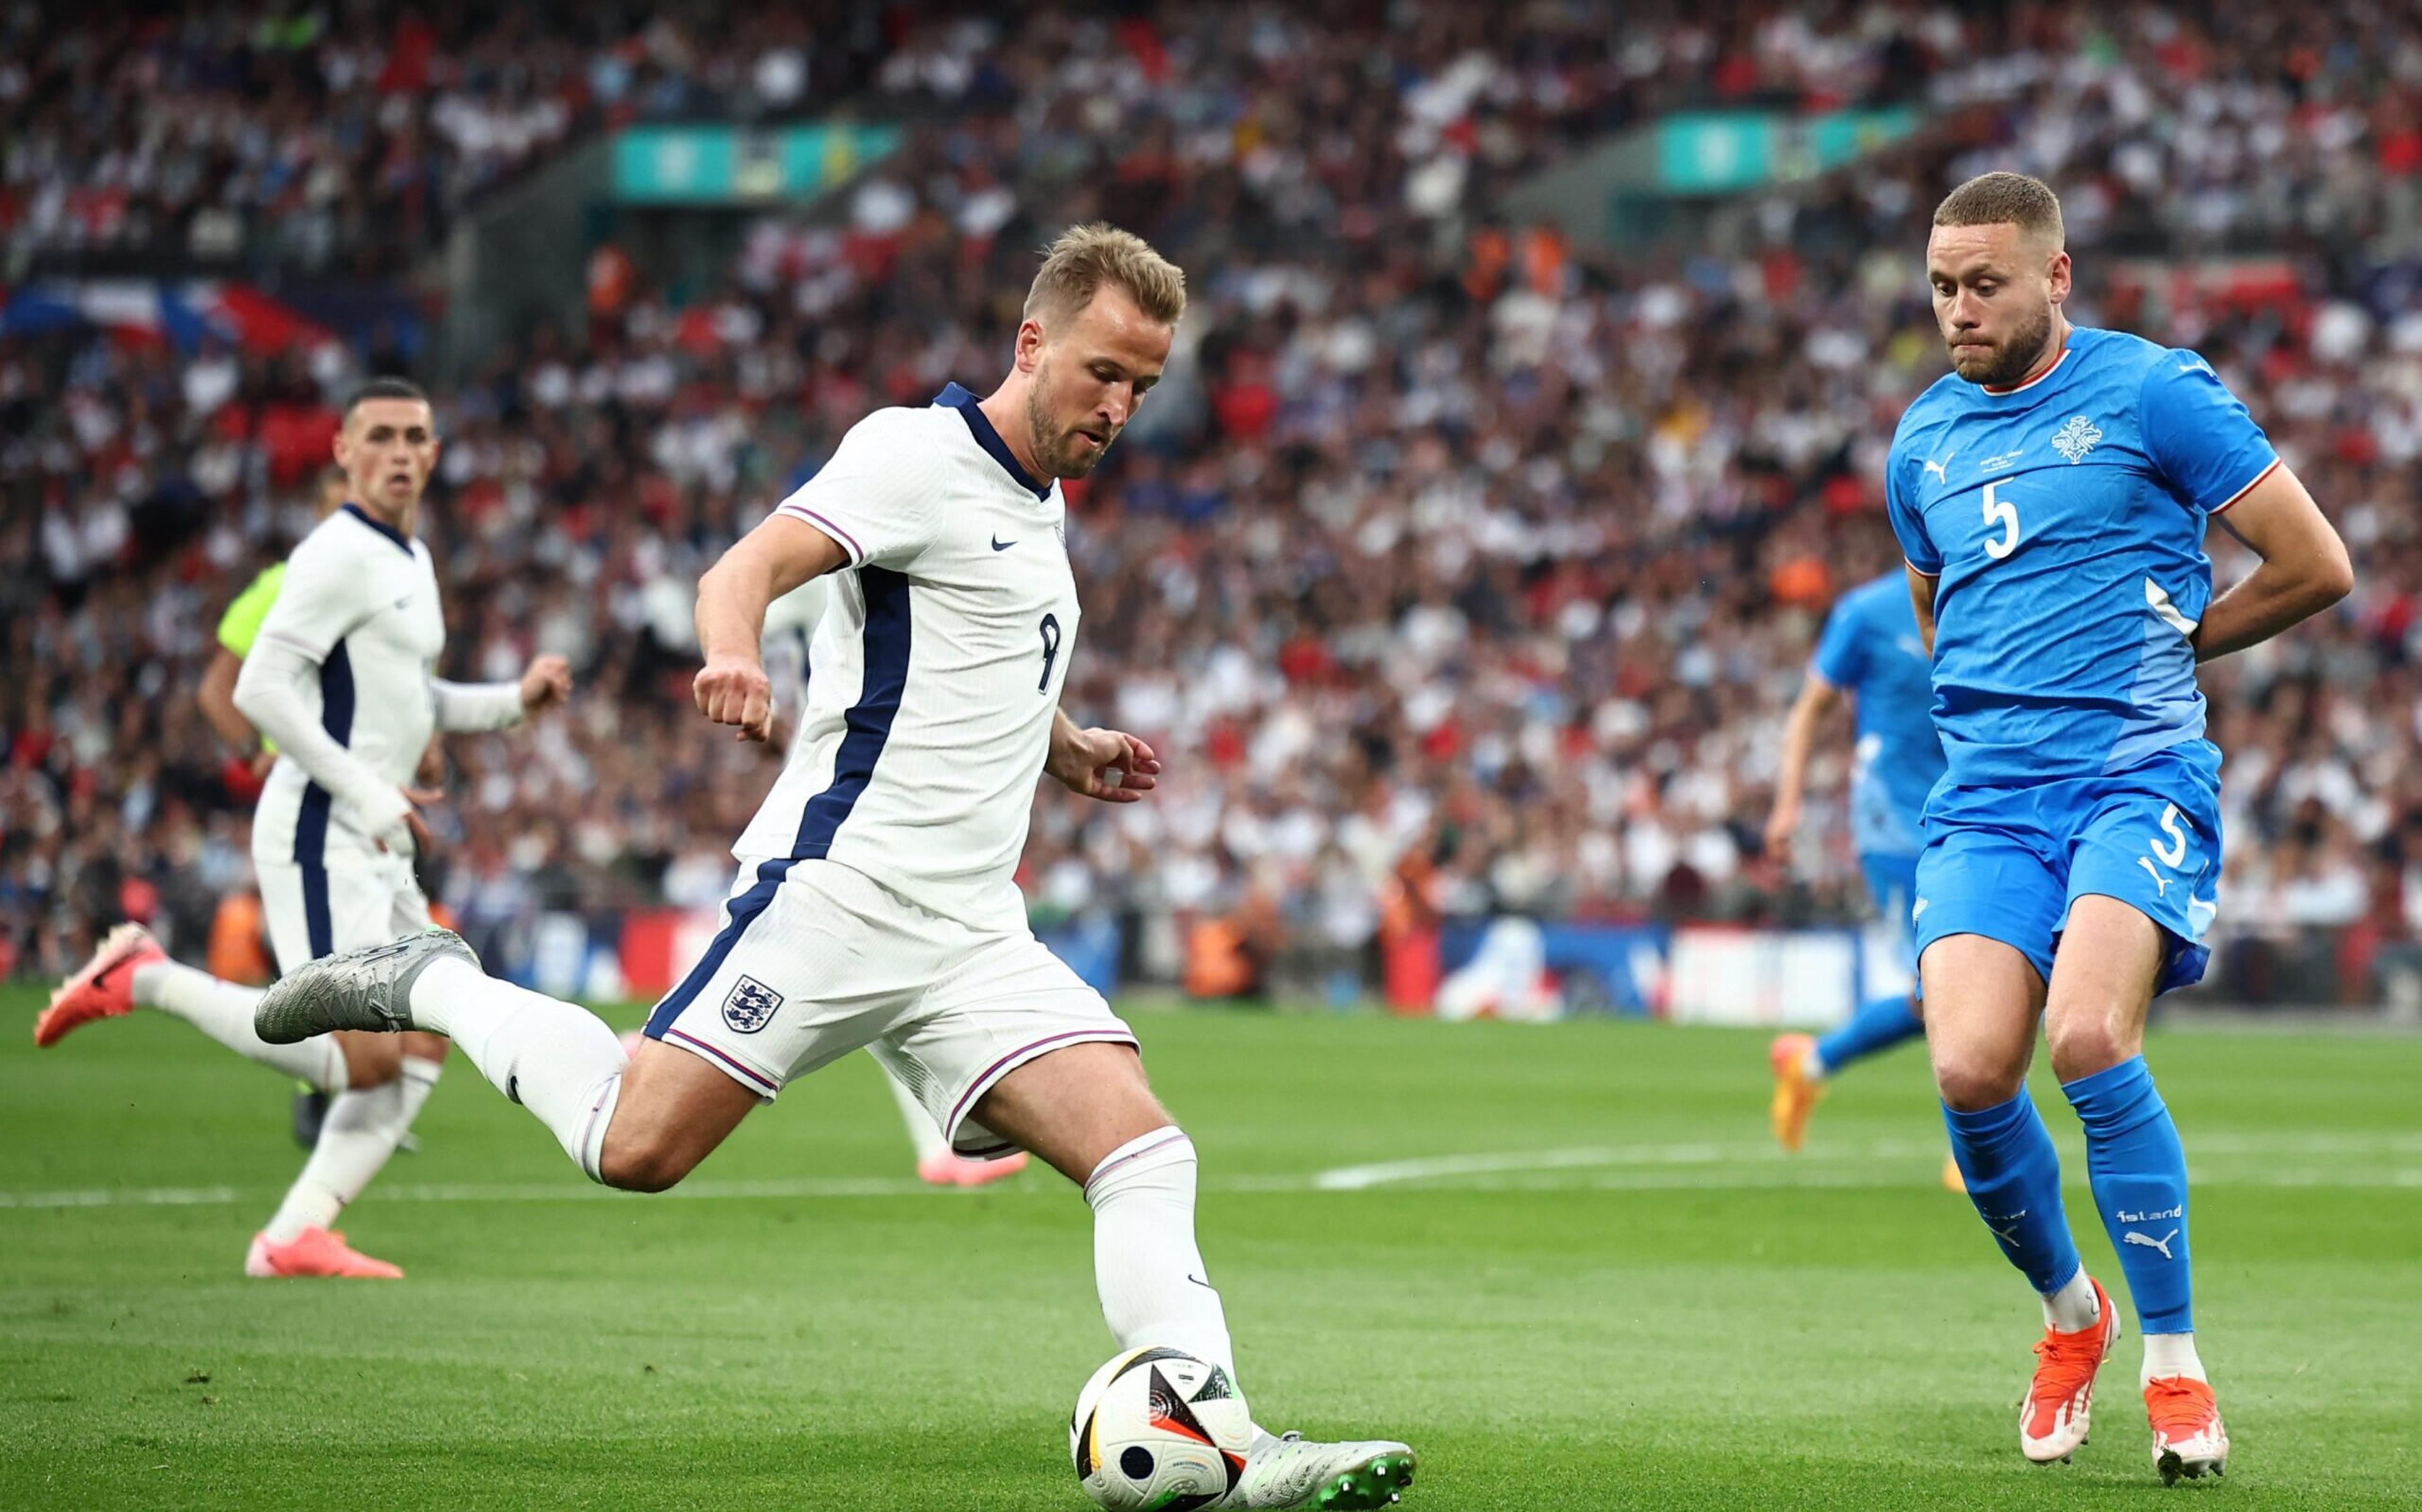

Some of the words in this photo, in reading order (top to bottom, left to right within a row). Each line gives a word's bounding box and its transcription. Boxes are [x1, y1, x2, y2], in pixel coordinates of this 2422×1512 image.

[1982, 477, 2020, 559] 5
[1038, 613, 1061, 695] 9
[2150, 802, 2193, 869] 5
